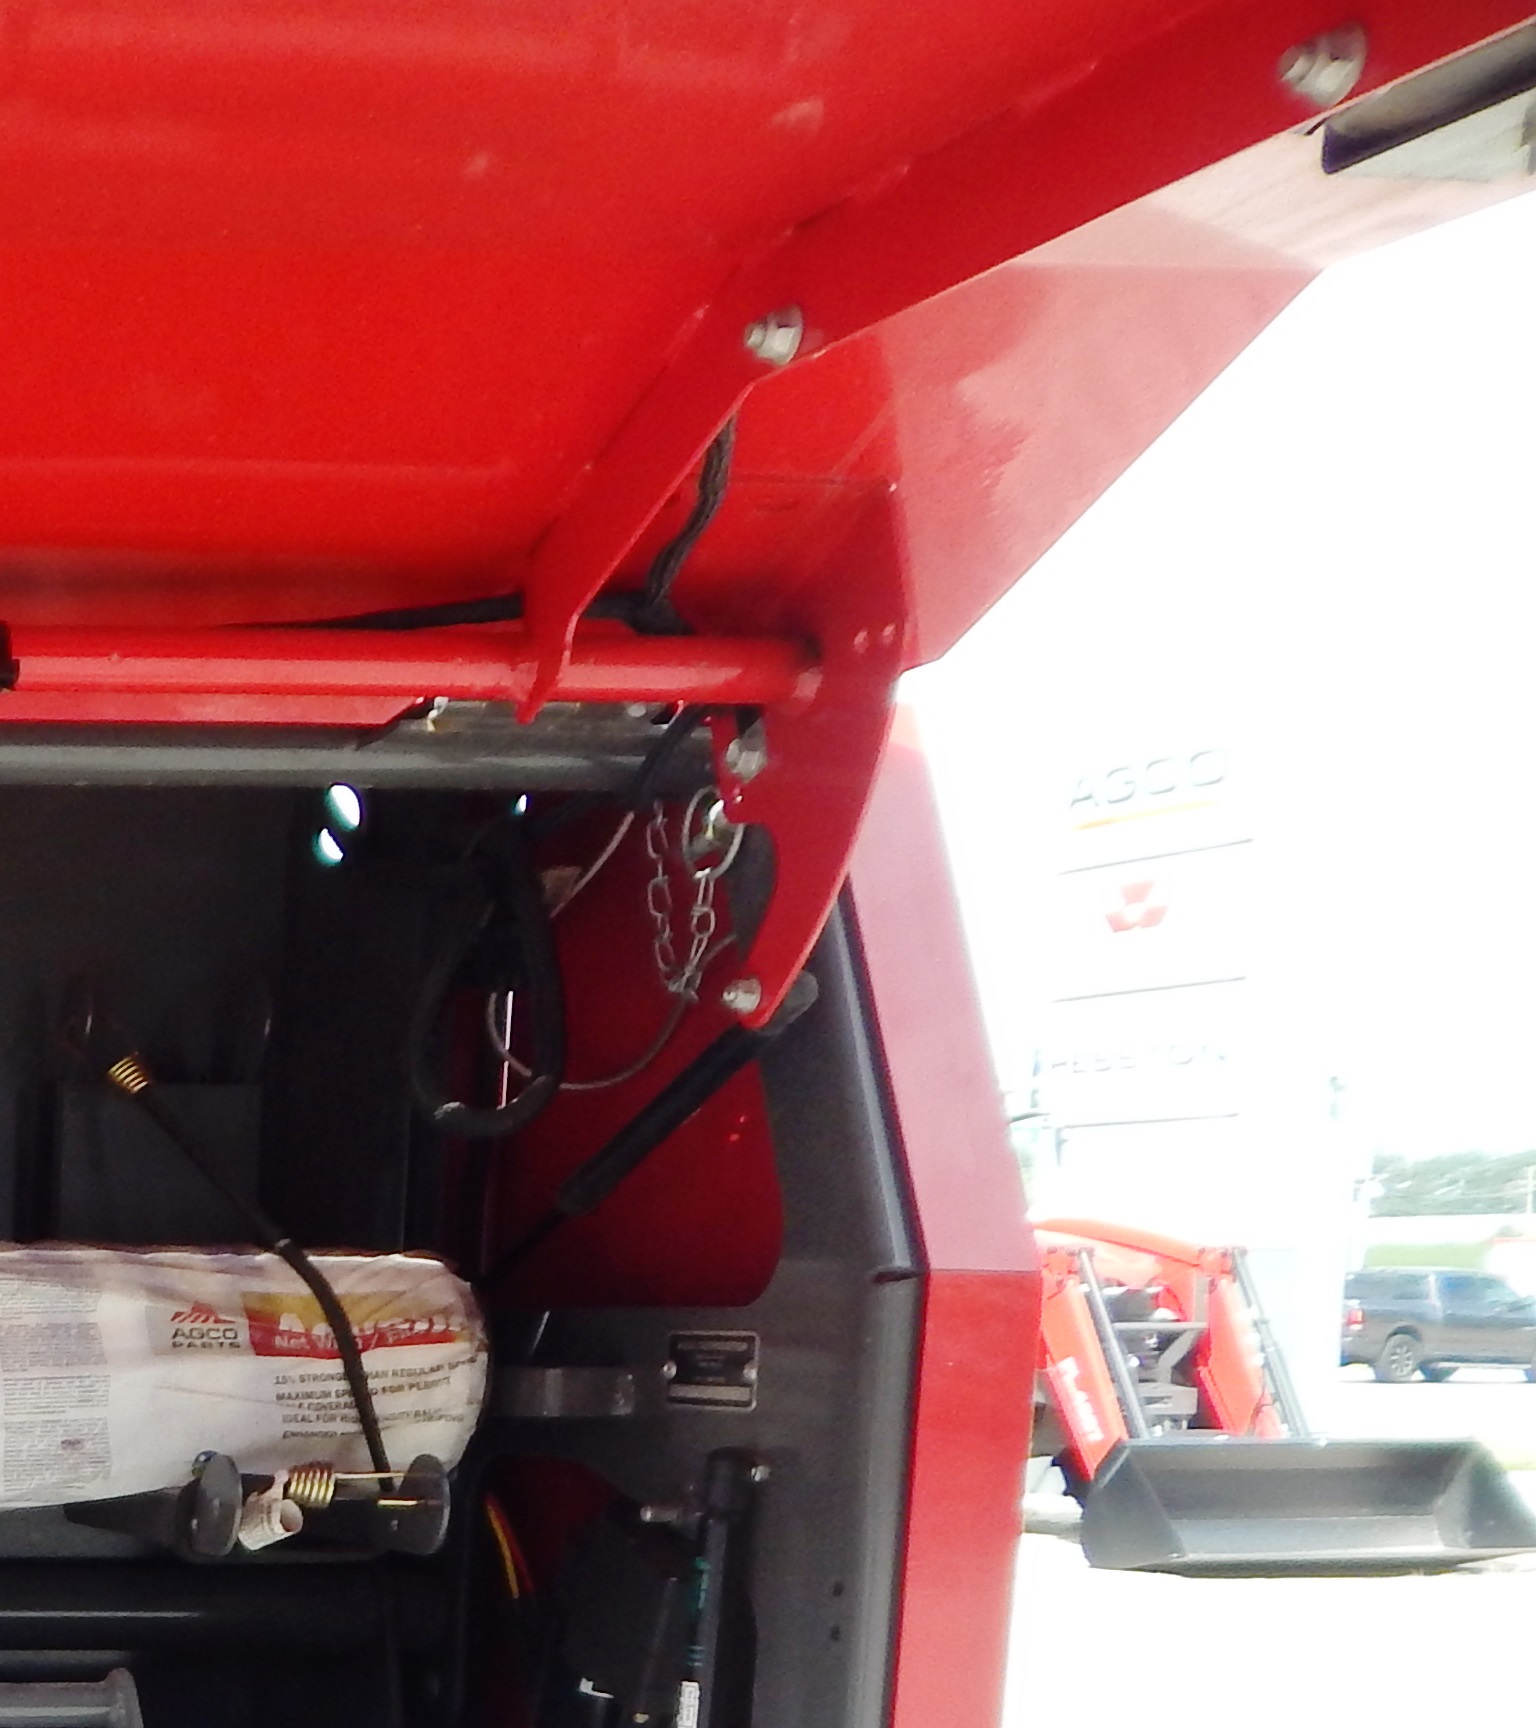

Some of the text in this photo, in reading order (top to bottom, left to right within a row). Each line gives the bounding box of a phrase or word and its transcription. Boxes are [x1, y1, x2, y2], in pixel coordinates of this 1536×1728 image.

[1068, 747, 1229, 811] AGCO
[1051, 1044, 1228, 1075] HESSO
[171, 1327, 238, 1340] AGCO
[171, 1341, 241, 1349] PARTS
